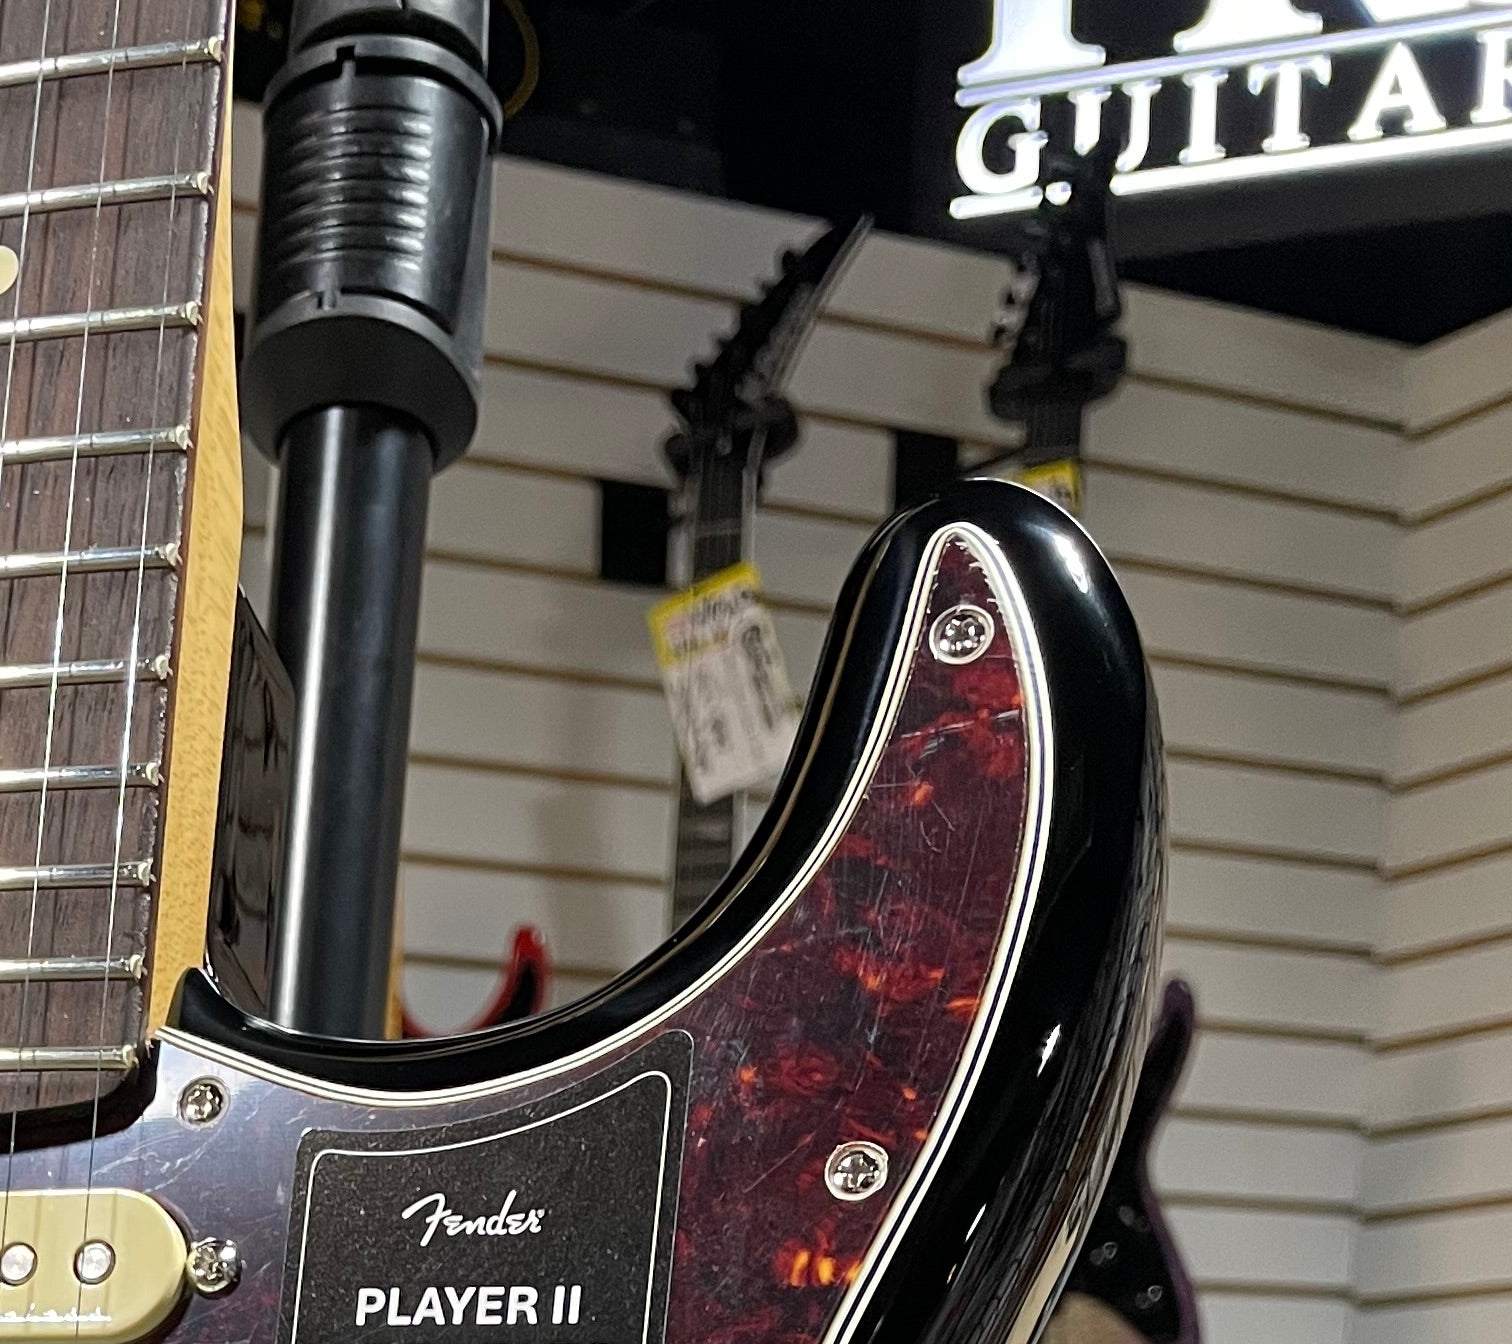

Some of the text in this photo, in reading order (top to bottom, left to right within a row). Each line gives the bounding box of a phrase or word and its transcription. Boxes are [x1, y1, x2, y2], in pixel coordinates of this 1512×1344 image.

[401, 1189, 545, 1247] Fender
[355, 1285, 582, 1327] PLAYER II
